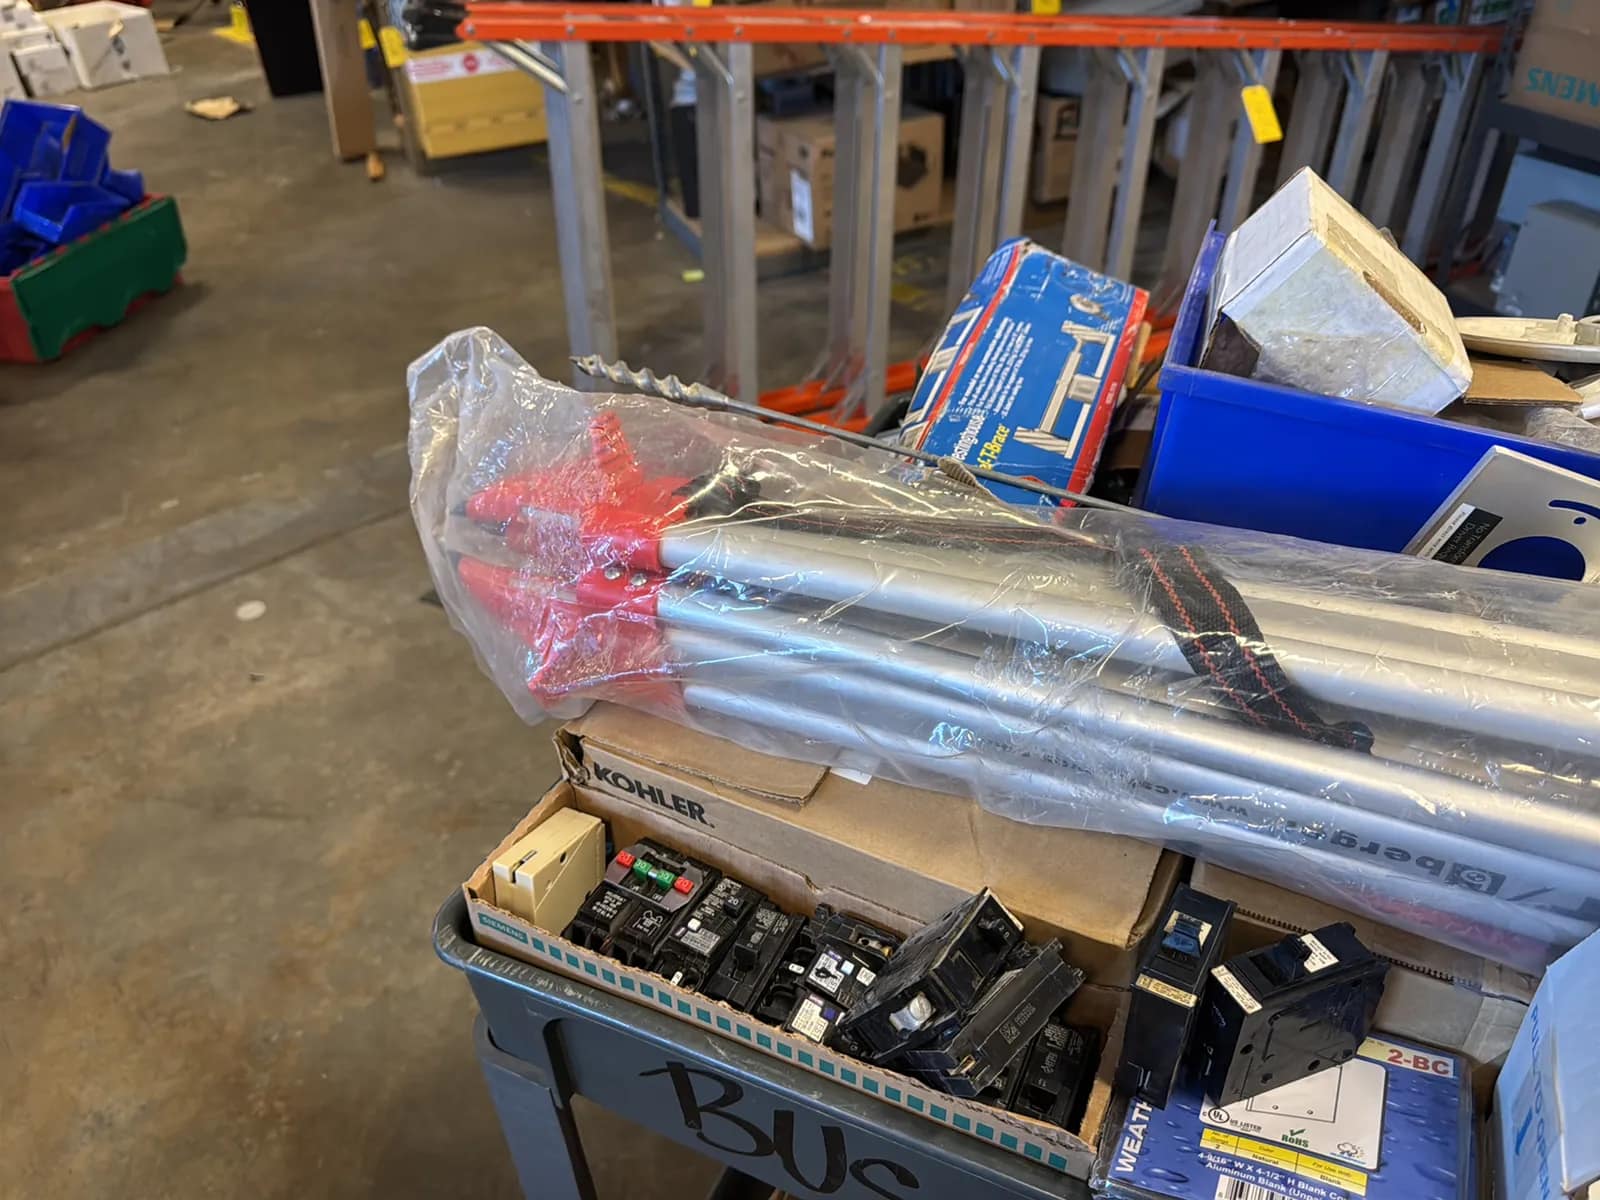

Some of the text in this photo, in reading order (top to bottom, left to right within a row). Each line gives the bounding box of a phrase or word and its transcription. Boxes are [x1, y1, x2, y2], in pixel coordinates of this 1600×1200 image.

[728, 896, 739, 906] 20
[481, 916, 527, 940] SIEMENS
[1387, 1048, 1450, 1075] 2-BC
[1252, 1154, 1279, 1165] Natural
[1205, 1162, 1256, 1182] Aluminum
[1257, 1177, 1286, 1194] Blank
[1233, 1161, 1245, 1169] W
[1287, 1177, 1296, 1186] H
[1298, 1181, 1327, 1197] Blank
[1320, 1174, 1342, 1185] Blank
